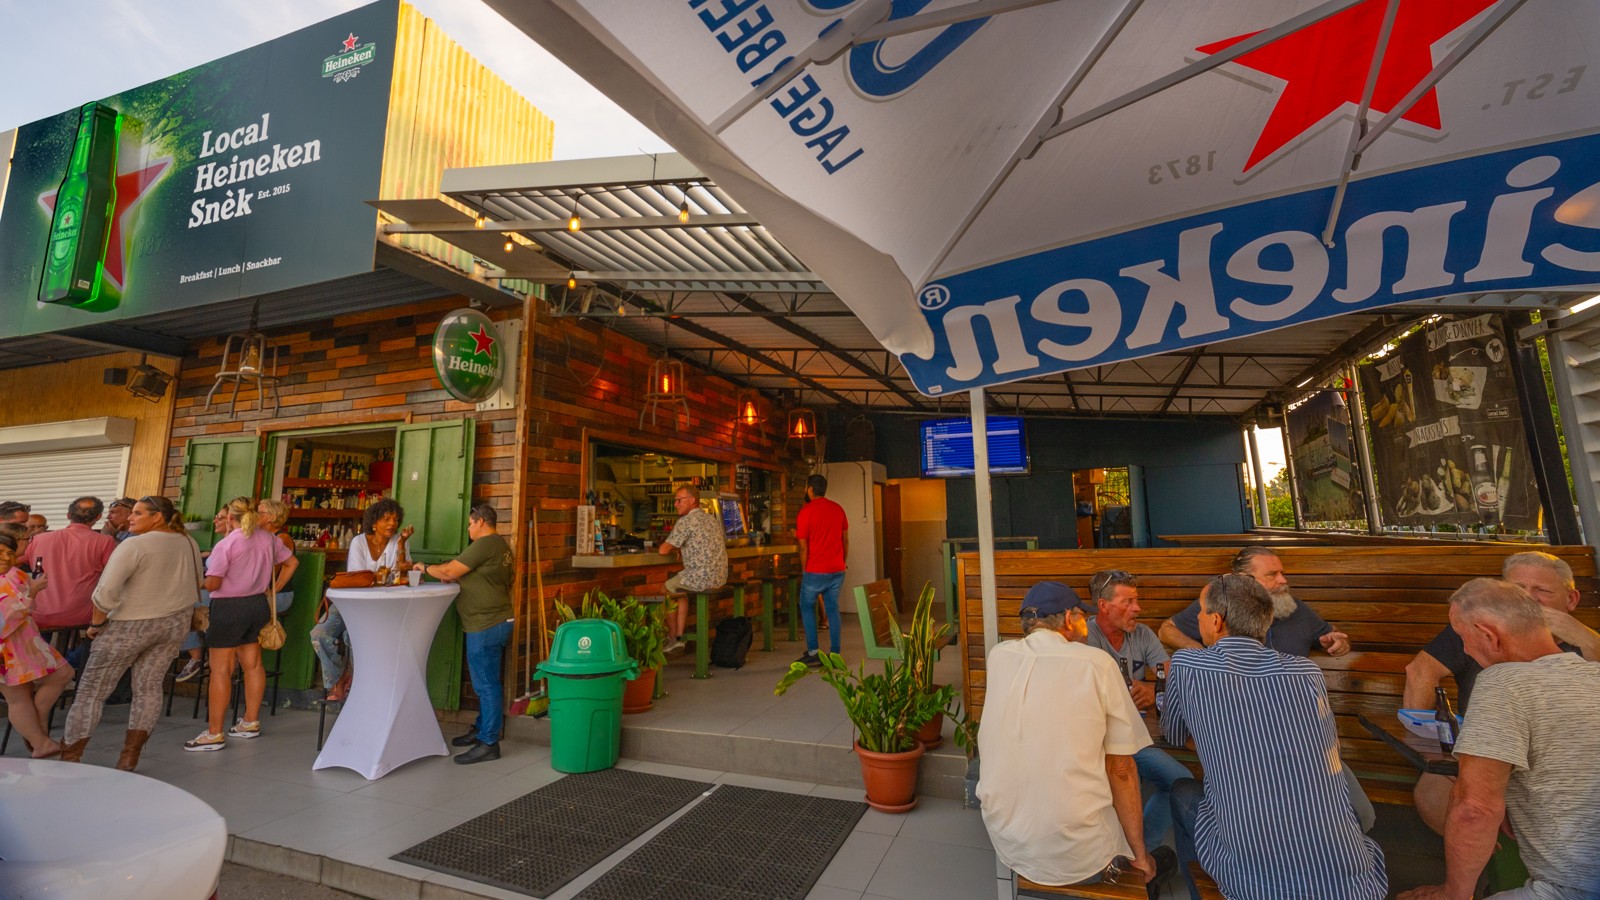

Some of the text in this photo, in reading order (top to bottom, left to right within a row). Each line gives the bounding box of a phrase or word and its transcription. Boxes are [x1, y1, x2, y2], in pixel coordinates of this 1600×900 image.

[325, 50, 372, 73] Heineken
[199, 112, 270, 159] Local
[193, 139, 321, 193] Heineken
[188, 188, 253, 229] Snèk
[257, 184, 291, 200] Est. 2015
[180, 270, 213, 284] Breakfast
[218, 264, 241, 276] Lunch
[246, 257, 282, 271] Snackbar
